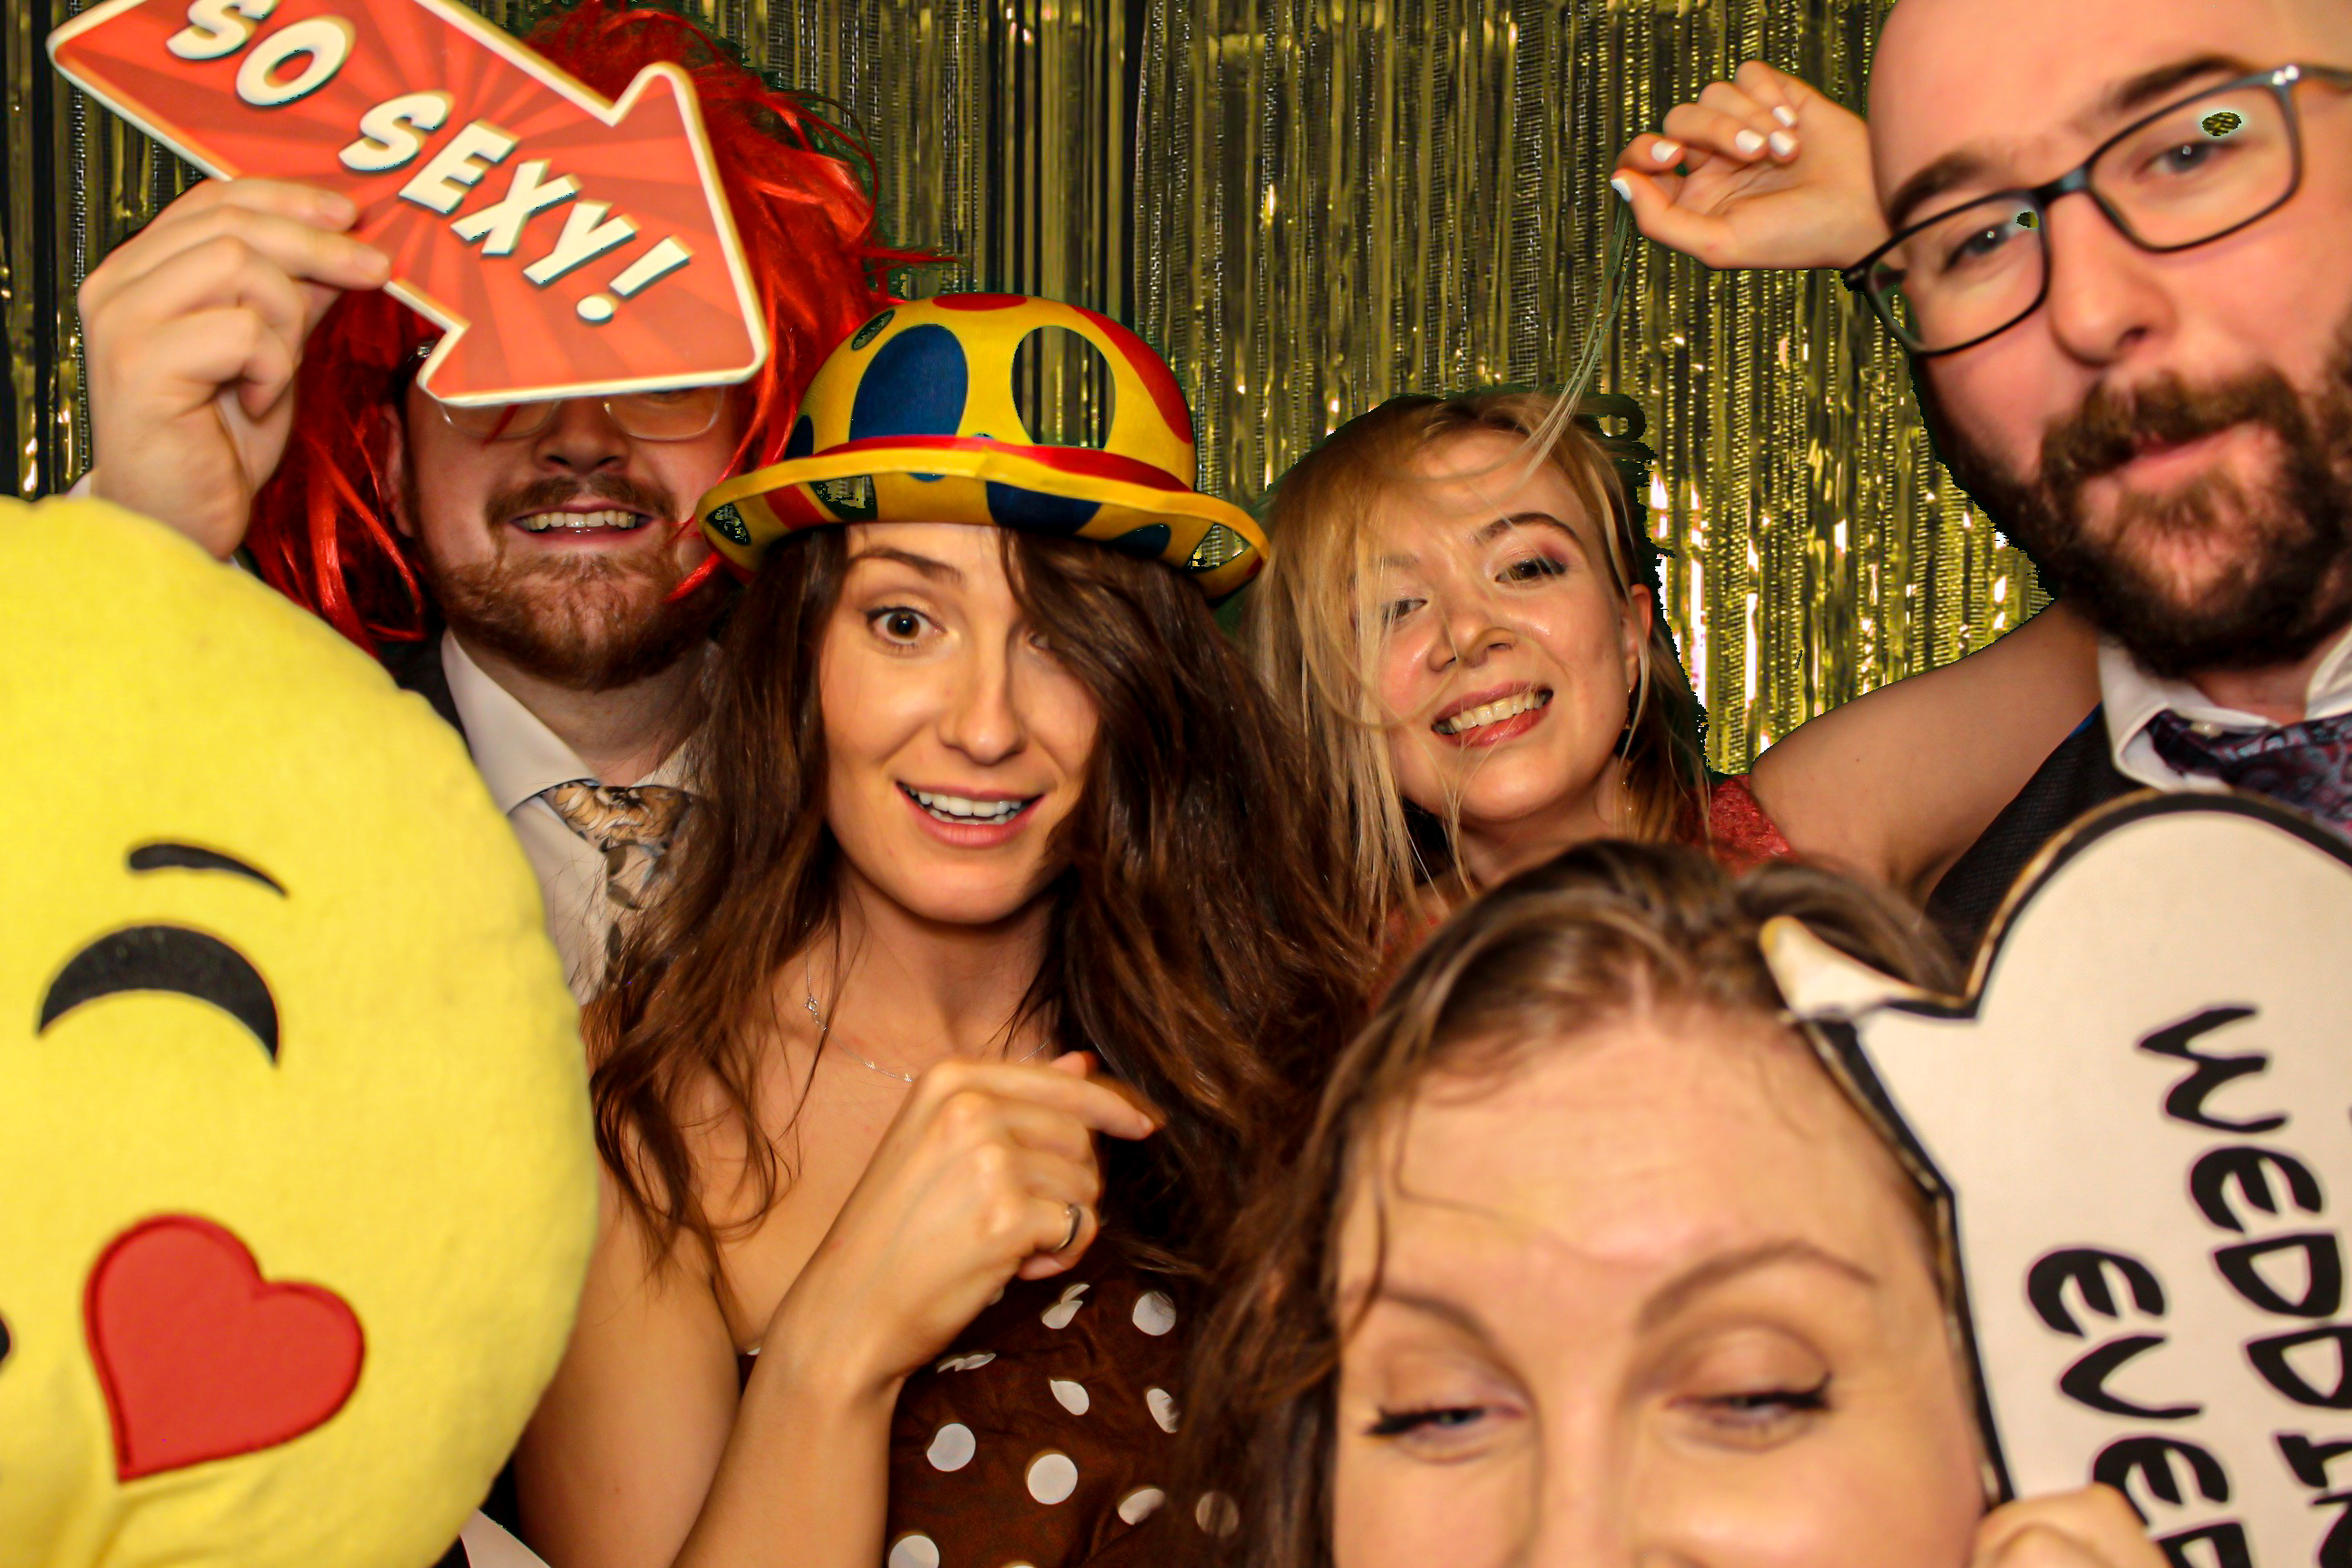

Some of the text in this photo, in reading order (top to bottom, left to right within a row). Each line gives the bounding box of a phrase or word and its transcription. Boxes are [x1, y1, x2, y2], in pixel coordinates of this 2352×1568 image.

[166, 0, 692, 324] SO SEXY!
[2138, 1004, 2352, 1568] WEDDI
